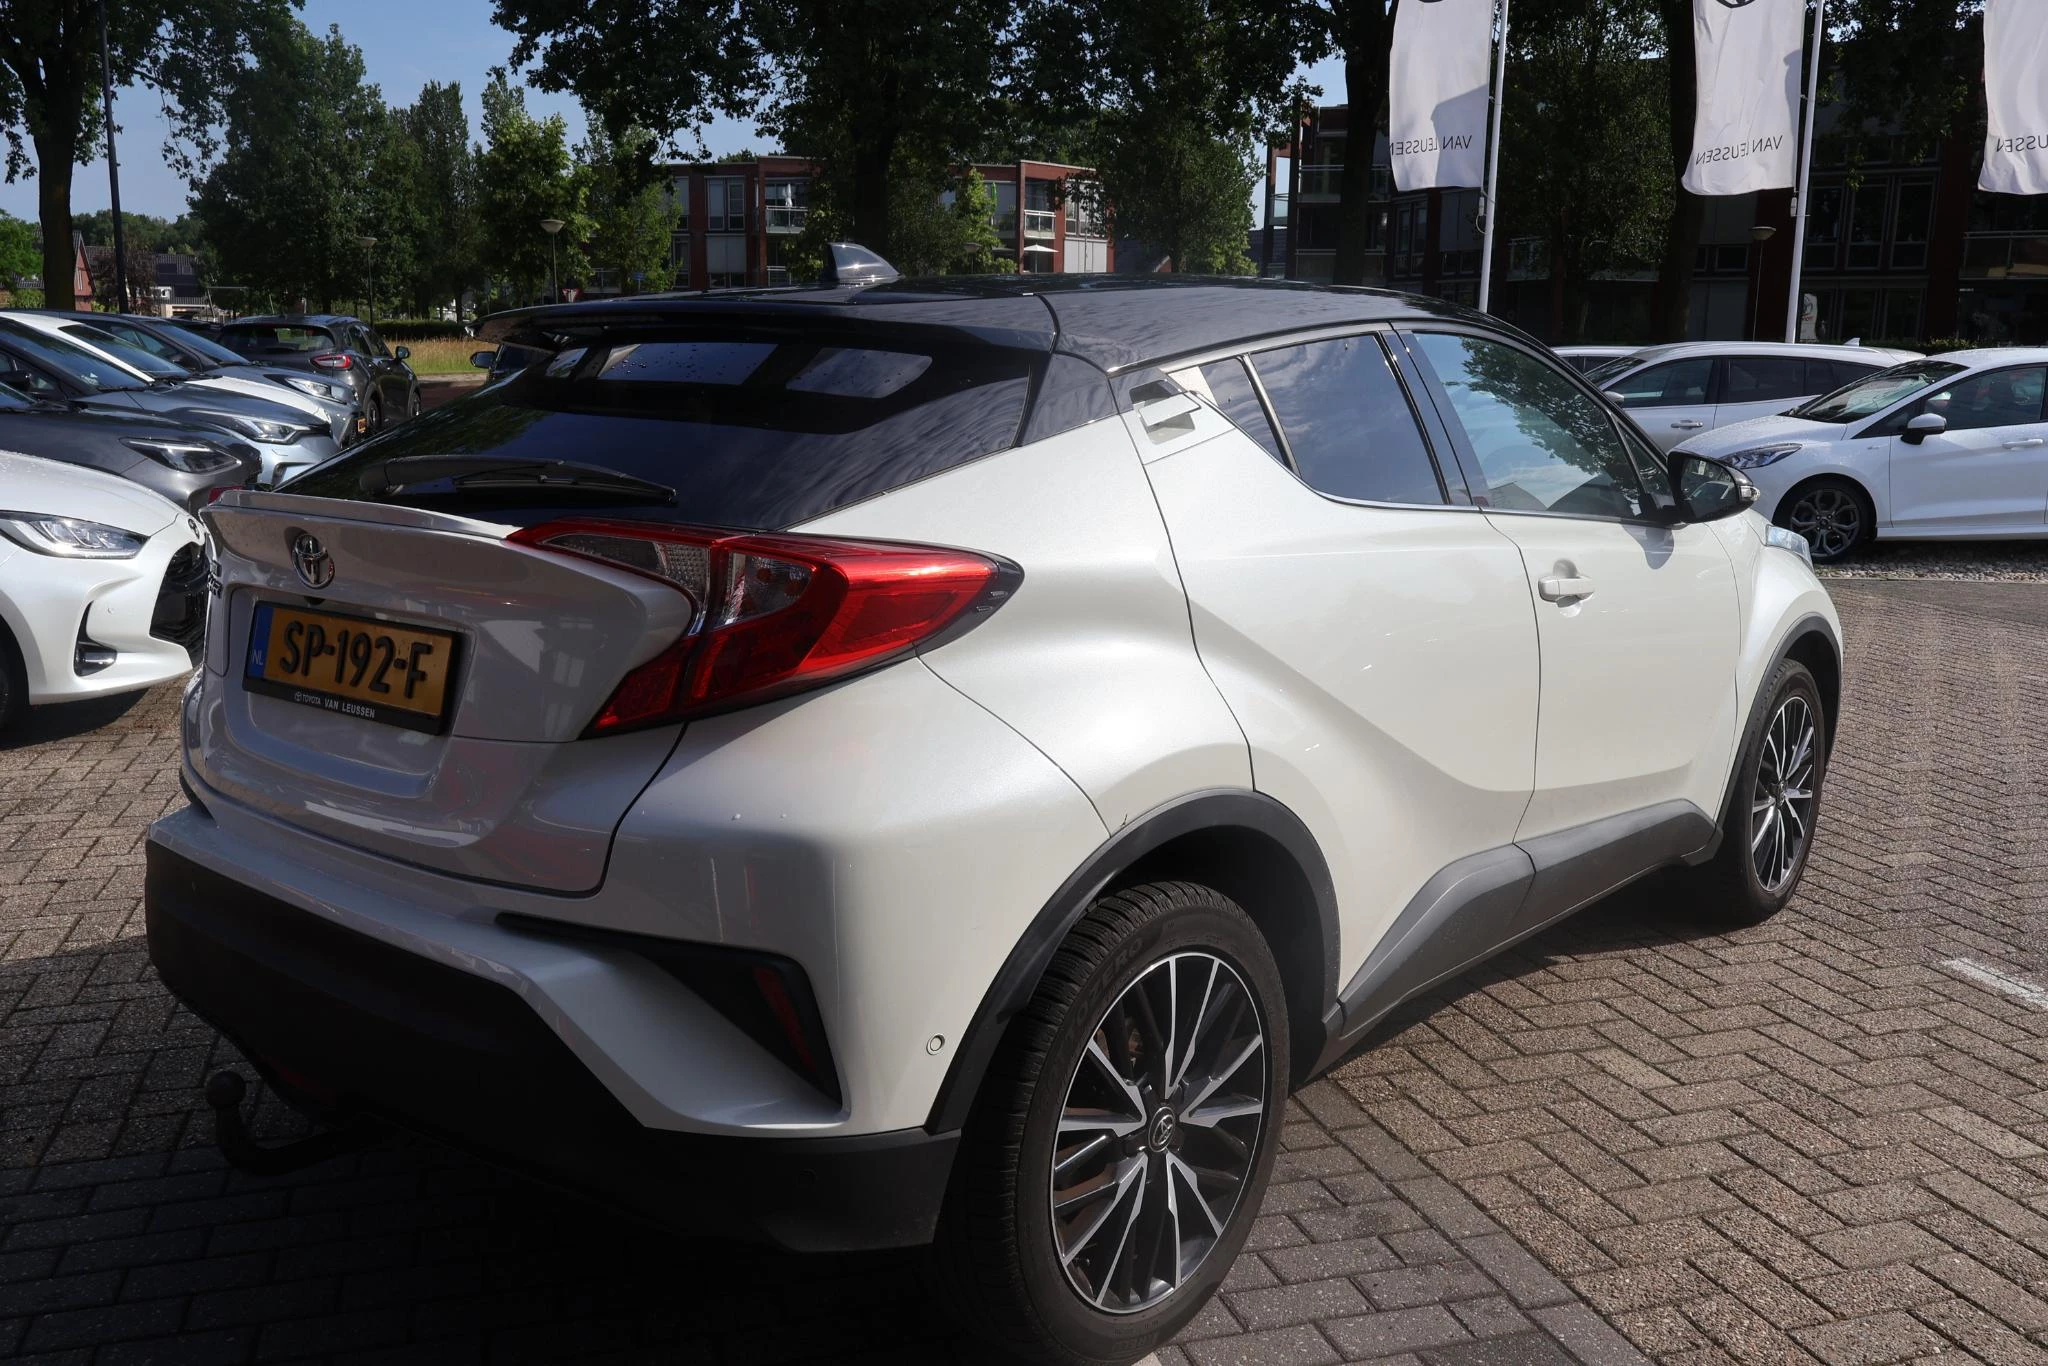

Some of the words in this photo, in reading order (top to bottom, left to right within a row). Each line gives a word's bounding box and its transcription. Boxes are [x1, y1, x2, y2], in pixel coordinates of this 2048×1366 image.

[251, 649, 264, 666] NL
[279, 619, 434, 700] SP-192-F
[302, 694, 321, 705] TOYOTA
[324, 698, 339, 711] VAN
[341, 702, 375, 719] LEUSSEN
